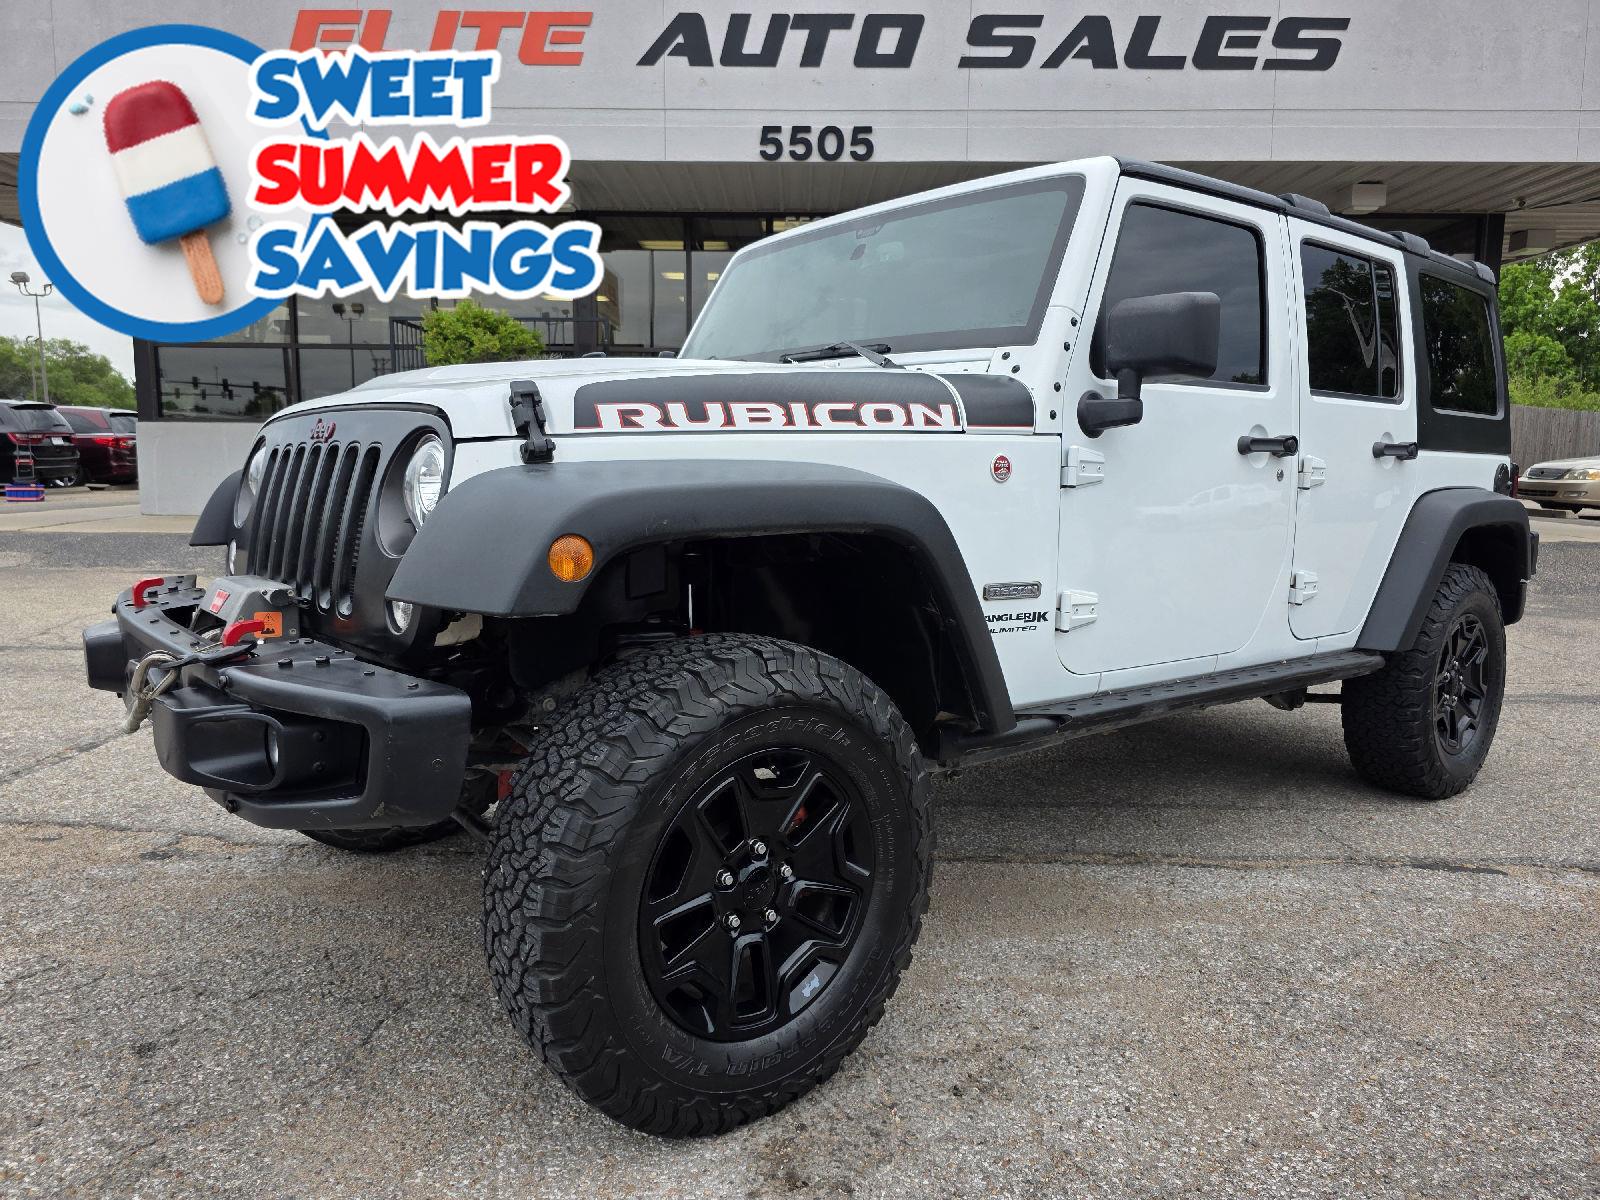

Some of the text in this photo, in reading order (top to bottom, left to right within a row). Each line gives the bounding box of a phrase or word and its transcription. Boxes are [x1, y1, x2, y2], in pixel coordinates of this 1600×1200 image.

[289, 10, 1352, 71] ELITE AUTO SALES
[758, 125, 875, 162] 5505
[594, 401, 962, 430] RUBICON
[989, 625, 1037, 633] LIMITED
